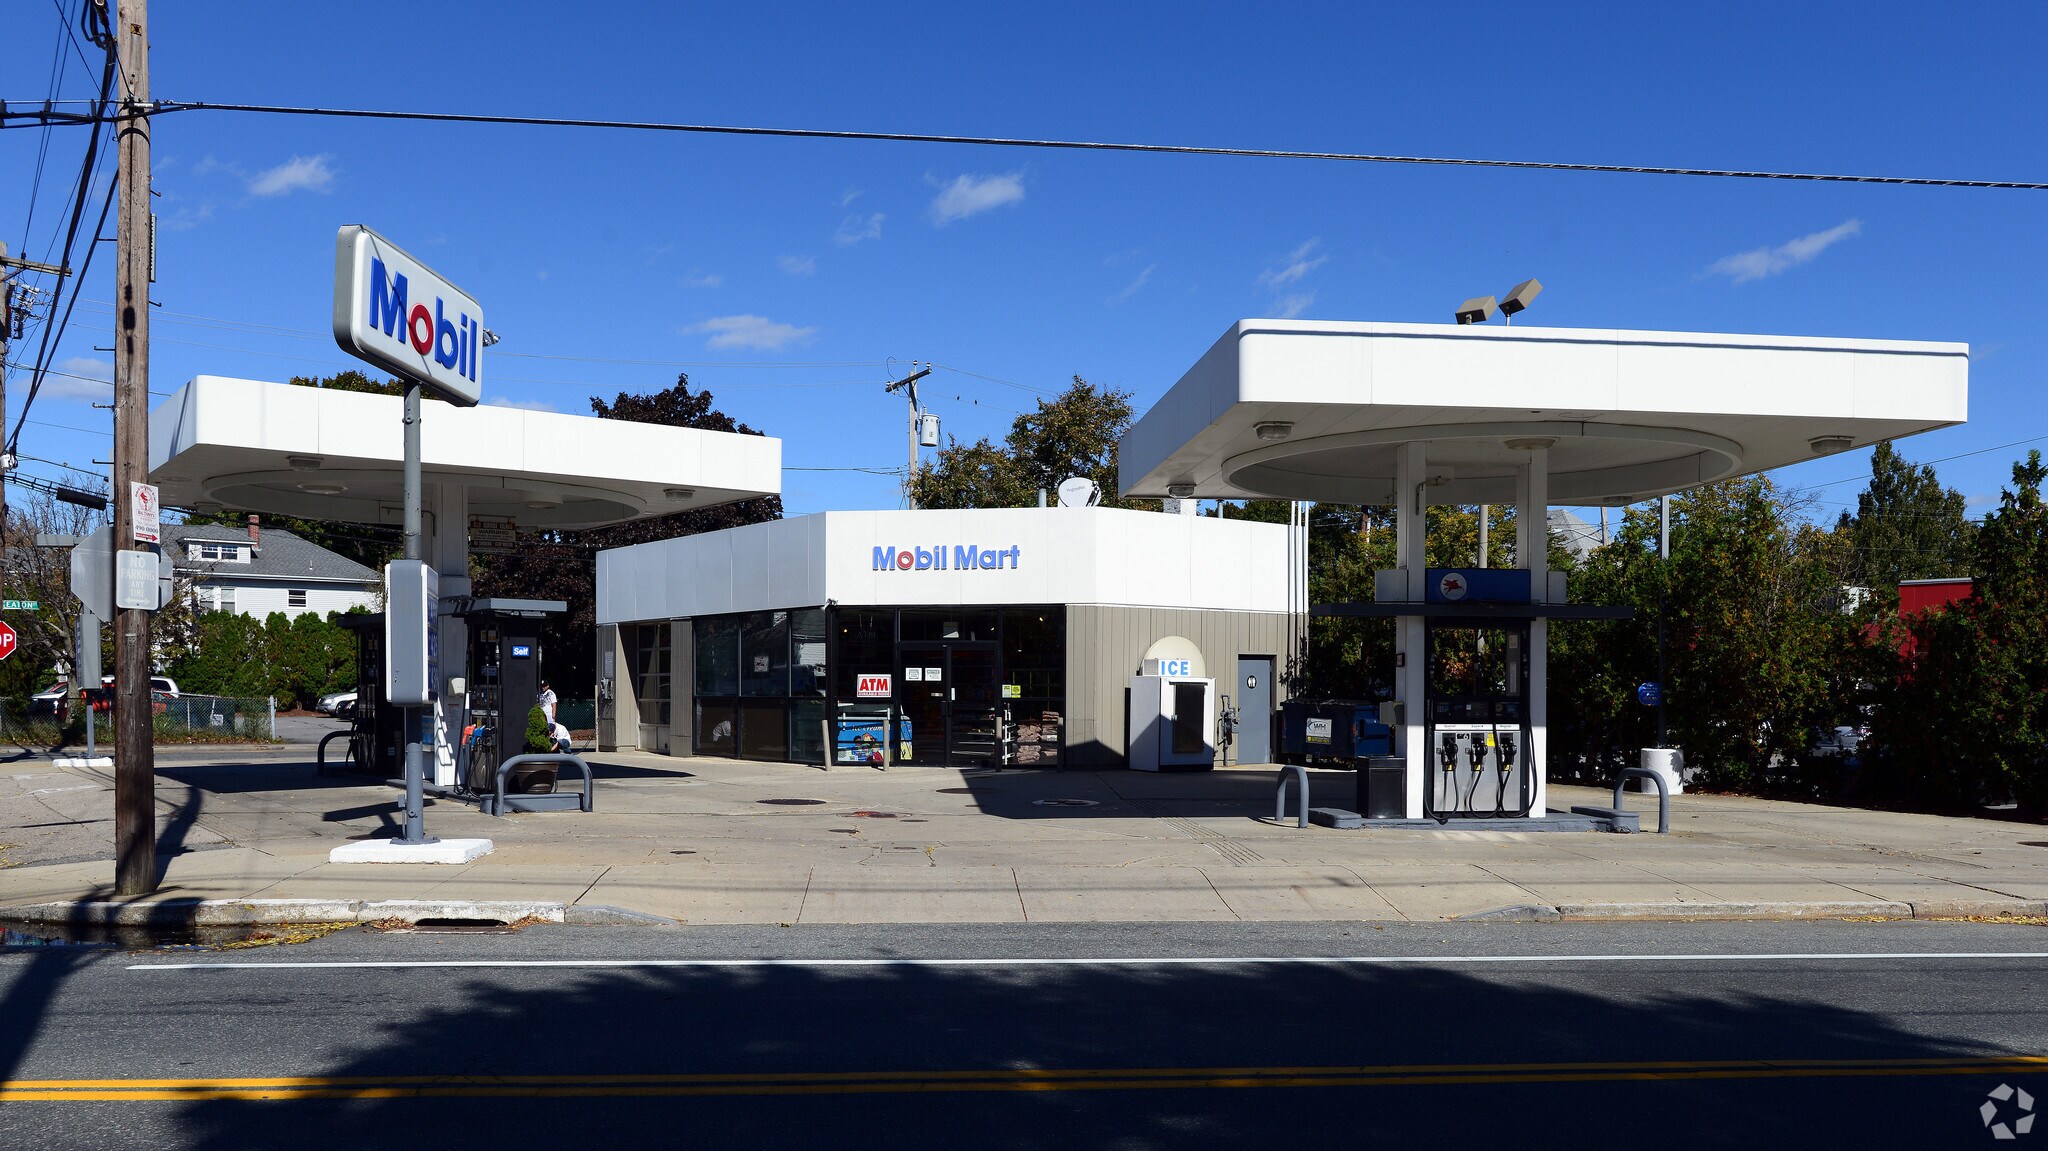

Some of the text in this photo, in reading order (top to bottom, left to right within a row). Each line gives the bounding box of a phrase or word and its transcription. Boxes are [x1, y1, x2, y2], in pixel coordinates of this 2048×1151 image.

[369, 256, 477, 383] Mobil
[130, 557, 146, 568] NO
[872, 544, 1020, 571] Mobil Mart
[120, 568, 155, 580] PARKING
[130, 580, 145, 589] ANY
[129, 589, 145, 598] TIME
[513, 647, 529, 656] Self
[1161, 661, 1189, 676] ICE
[859, 678, 888, 691] ATM
